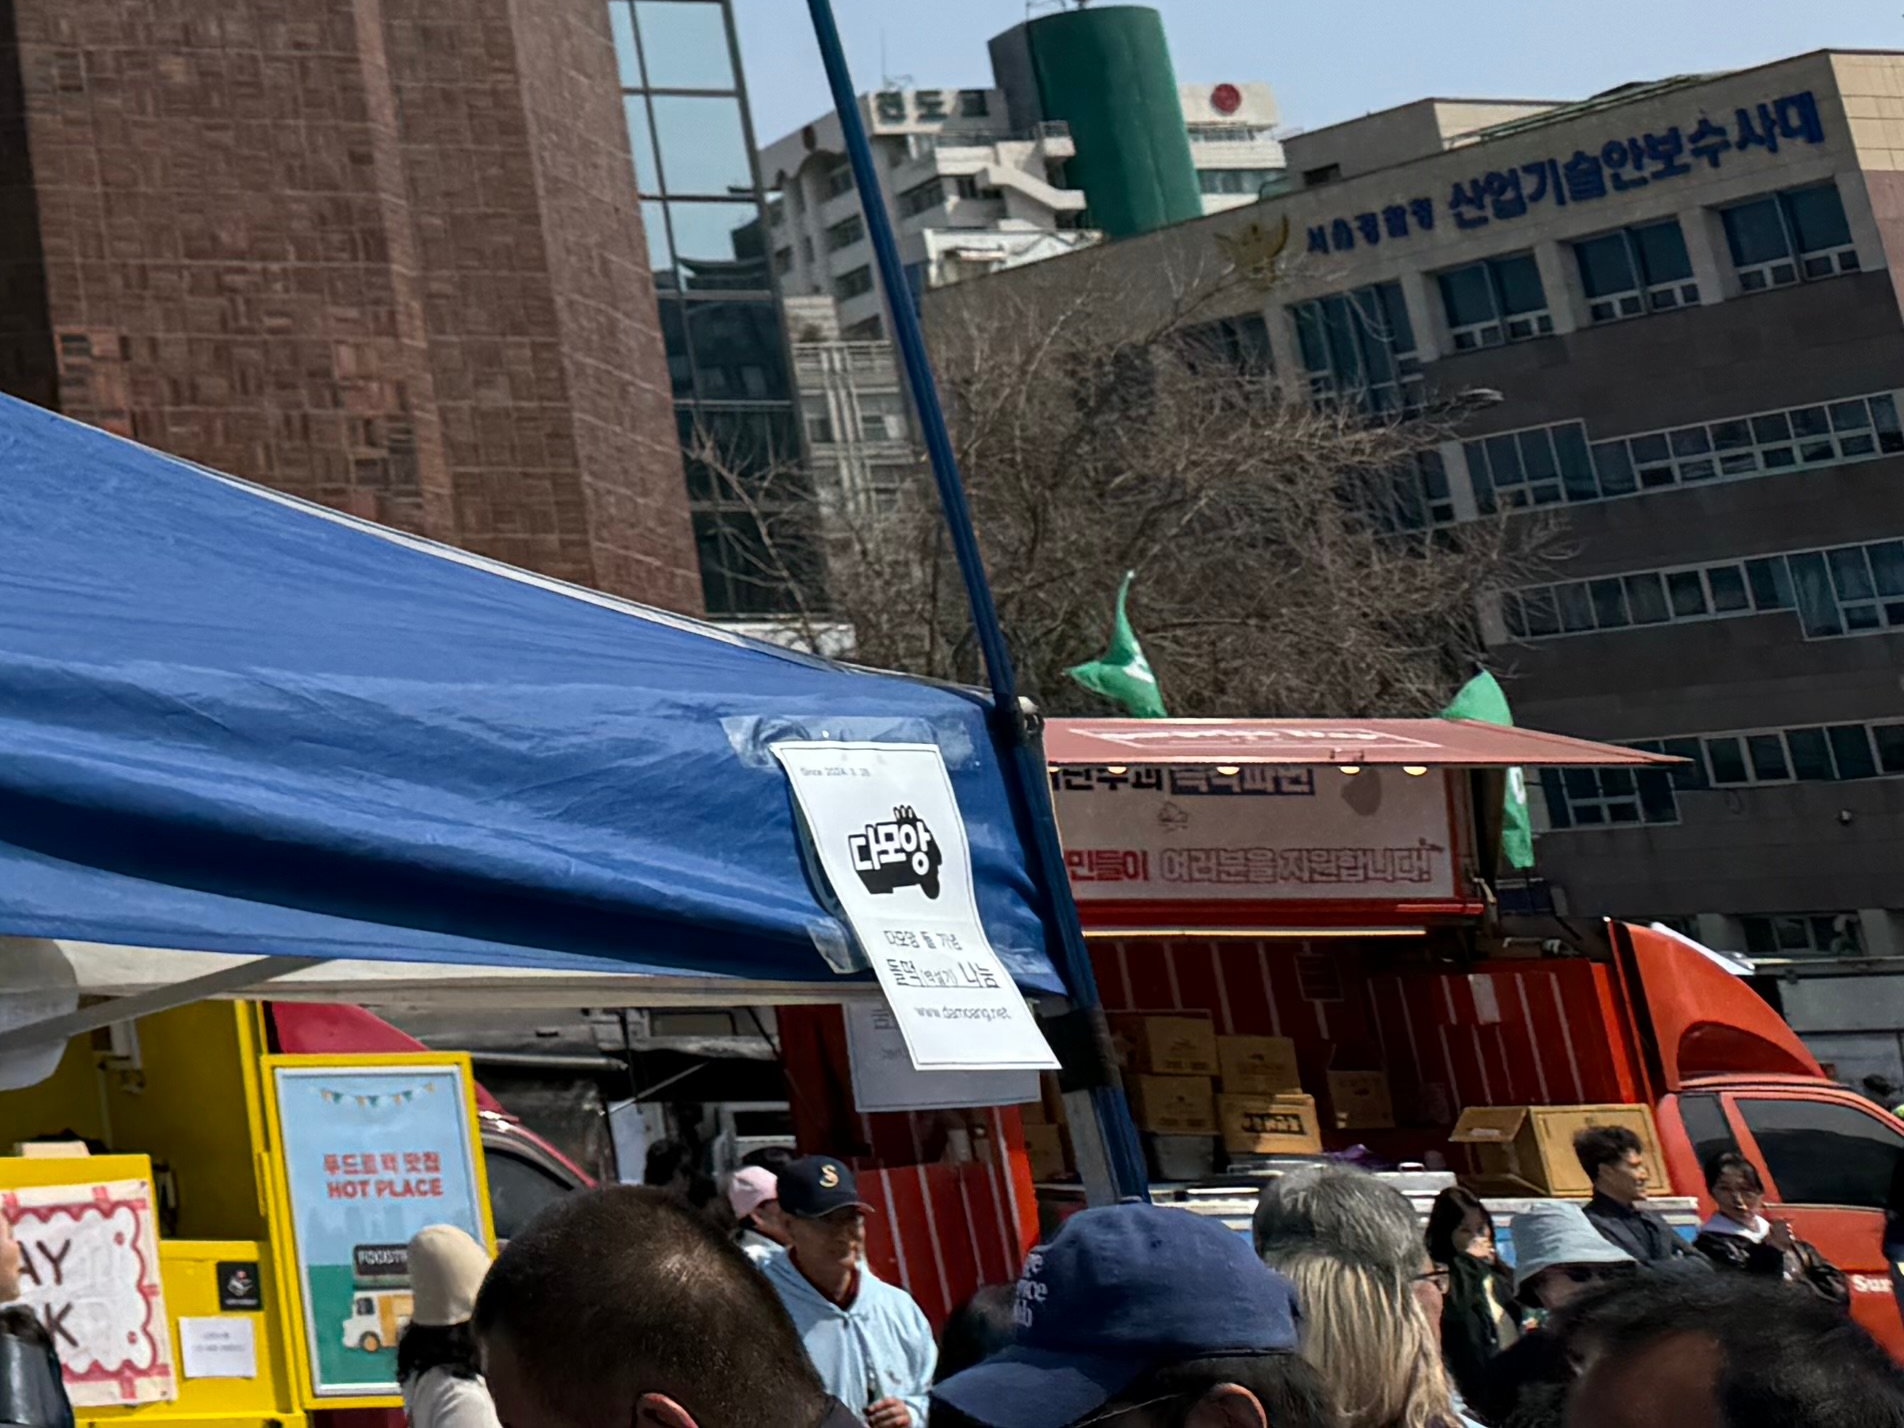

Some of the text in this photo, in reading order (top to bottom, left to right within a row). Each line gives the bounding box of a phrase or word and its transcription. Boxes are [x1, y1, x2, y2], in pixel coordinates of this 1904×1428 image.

[1448, 90, 1825, 230] 산업기술안보수사대
[849, 821, 932, 876] 다모앙
[1160, 847, 1278, 884] 여러분을
[327, 1178, 444, 1199] HOT PLACE
